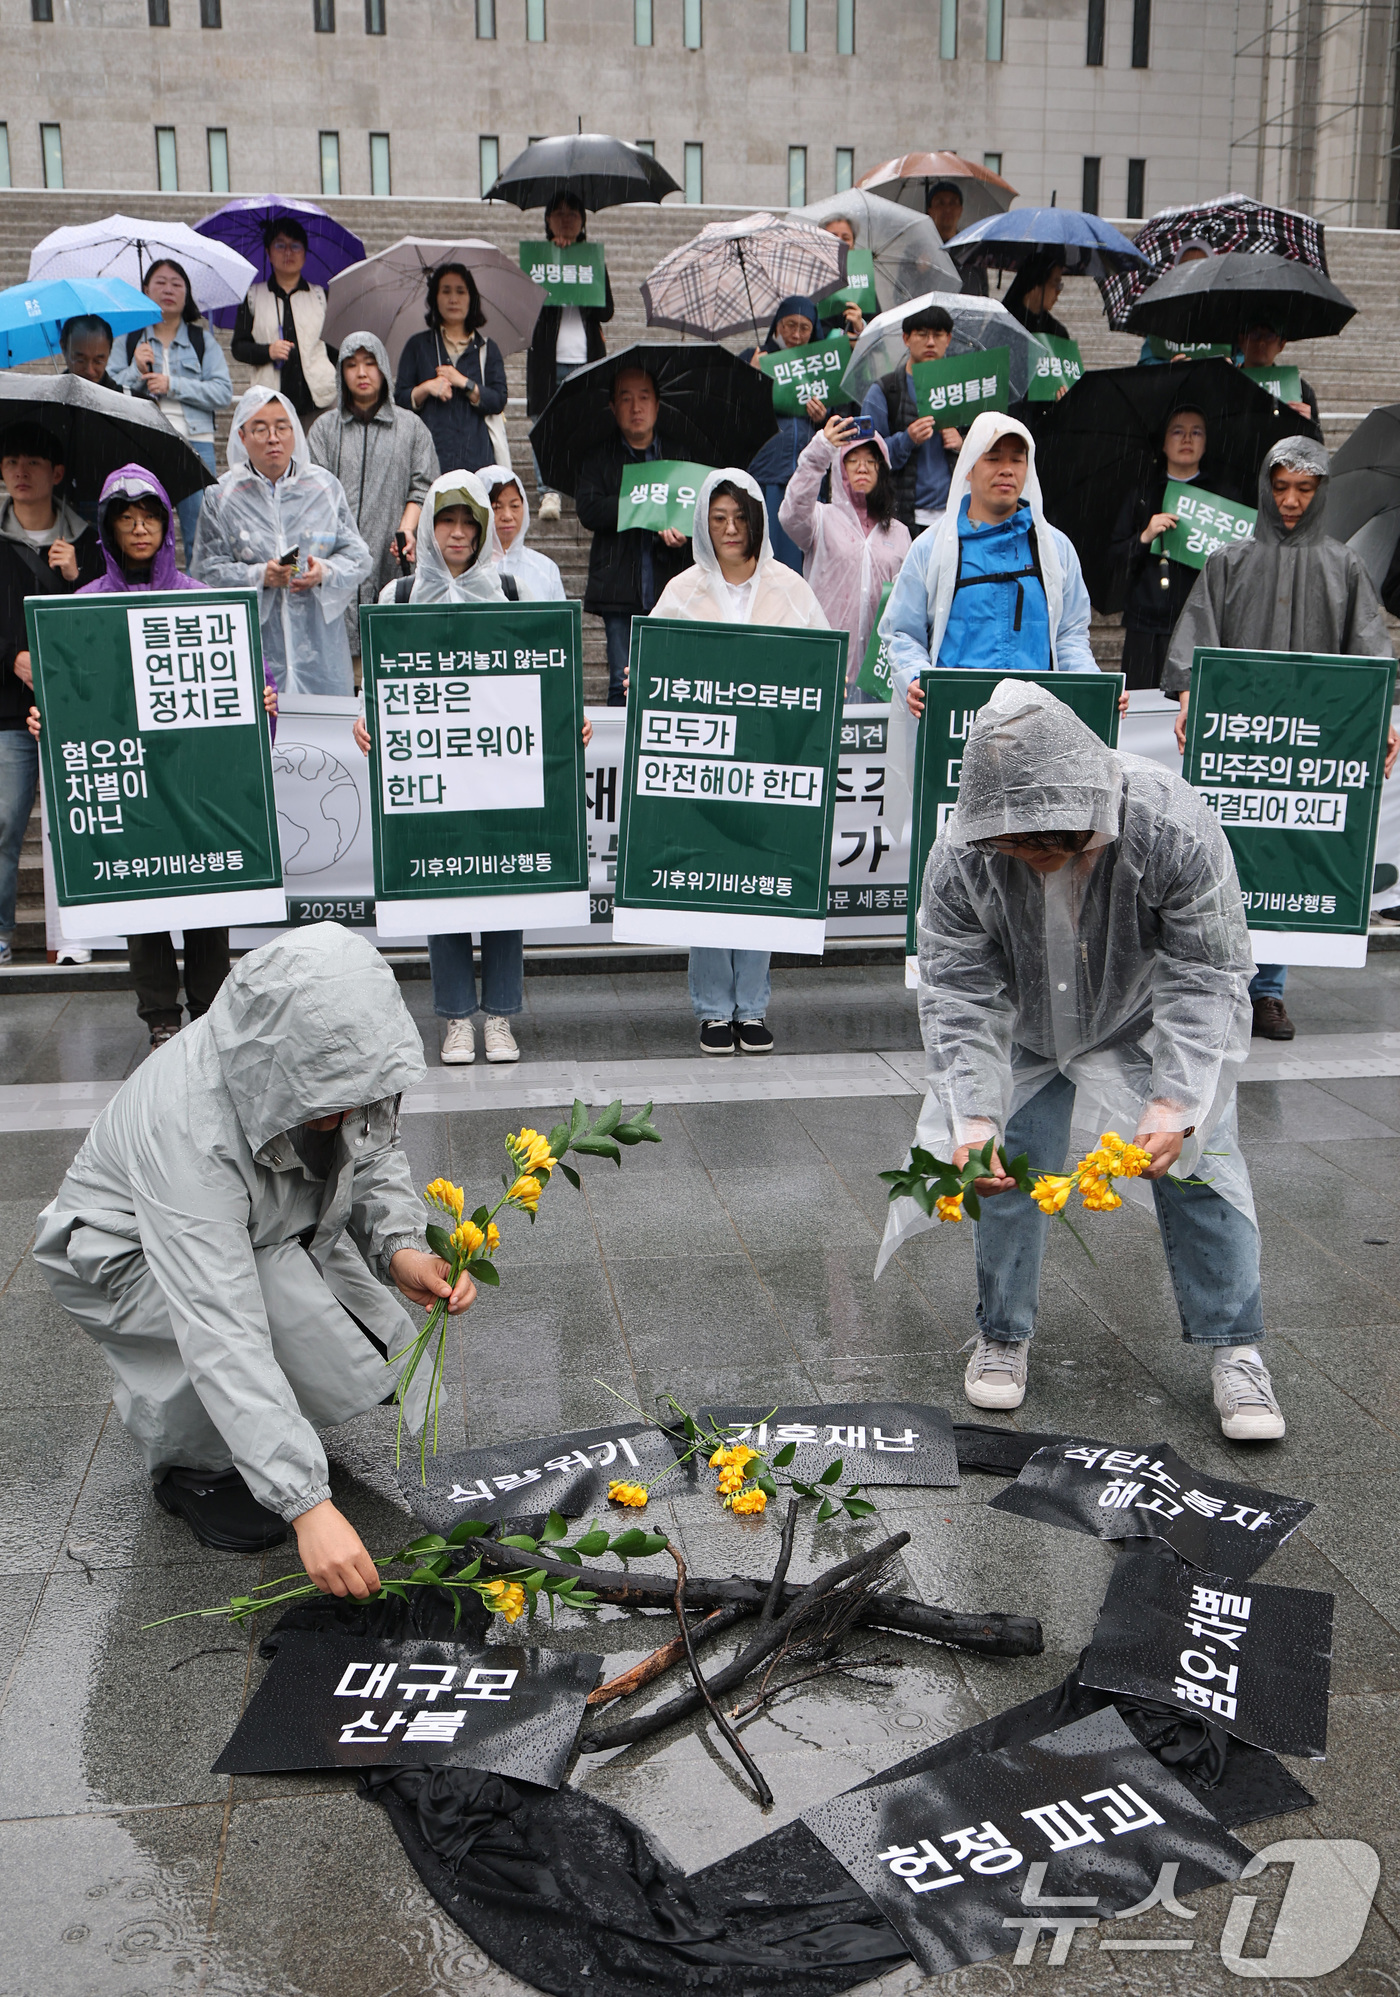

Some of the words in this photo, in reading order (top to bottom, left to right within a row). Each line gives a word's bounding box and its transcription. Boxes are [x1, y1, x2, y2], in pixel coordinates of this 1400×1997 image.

[530, 264, 594, 284] 생명돌봄
[773, 350, 841, 386] 민주주의
[1036, 357, 1062, 377] 생명
[1062, 359, 1081, 380] 우선
[795, 379, 829, 405] 강화
[928, 374, 998, 411] 생명돌봄
[630, 483, 669, 505] 생명
[1176, 495, 1254, 540] 민주주의
[141, 613, 236, 649] 돌봄과
[146, 651, 238, 687] 연대의
[379, 652, 432, 674] 누구도
[437, 650, 508, 673] 남겨놓지
[513, 648, 567, 670] 않는다
[149, 687, 242, 725] 정치로
[382, 681, 471, 717] 전환은
[649, 677, 822, 712] 기후재난으로부터
[385, 726, 535, 764] 정의로워야
[646, 716, 730, 749] 모두가
[1203, 712, 1321, 747] 기후위기는
[61, 738, 147, 771] 혐오와
[1200, 752, 1293, 785] 민주주의
[1296, 757, 1370, 789] 위기와
[65, 770, 148, 803] 차별이
[386, 773, 446, 808] 한다
[644, 762, 754, 797] 안전해야
[763, 768, 818, 801] 한다
[69, 804, 124, 835] 아닌
[1294, 798, 1341, 826] 있다
[92, 850, 244, 883] 기후위기비상행동
[409, 852, 552, 879] 기후위기비상행동
[651, 869, 793, 897] 기후위기비상행동
[299, 901, 365, 920] 2025년
[727, 1423, 919, 1452] 기후재난
[447, 1437, 640, 1504] 식량위기
[1064, 1447, 1271, 1531] 석탄노동자
[1098, 1478, 1185, 1521] 해고
[332, 1662, 519, 1702] 대규모
[337, 1709, 467, 1744] 산불
[876, 1821, 1023, 1894] 헌정
[1021, 1783, 1166, 1853] 파괴
